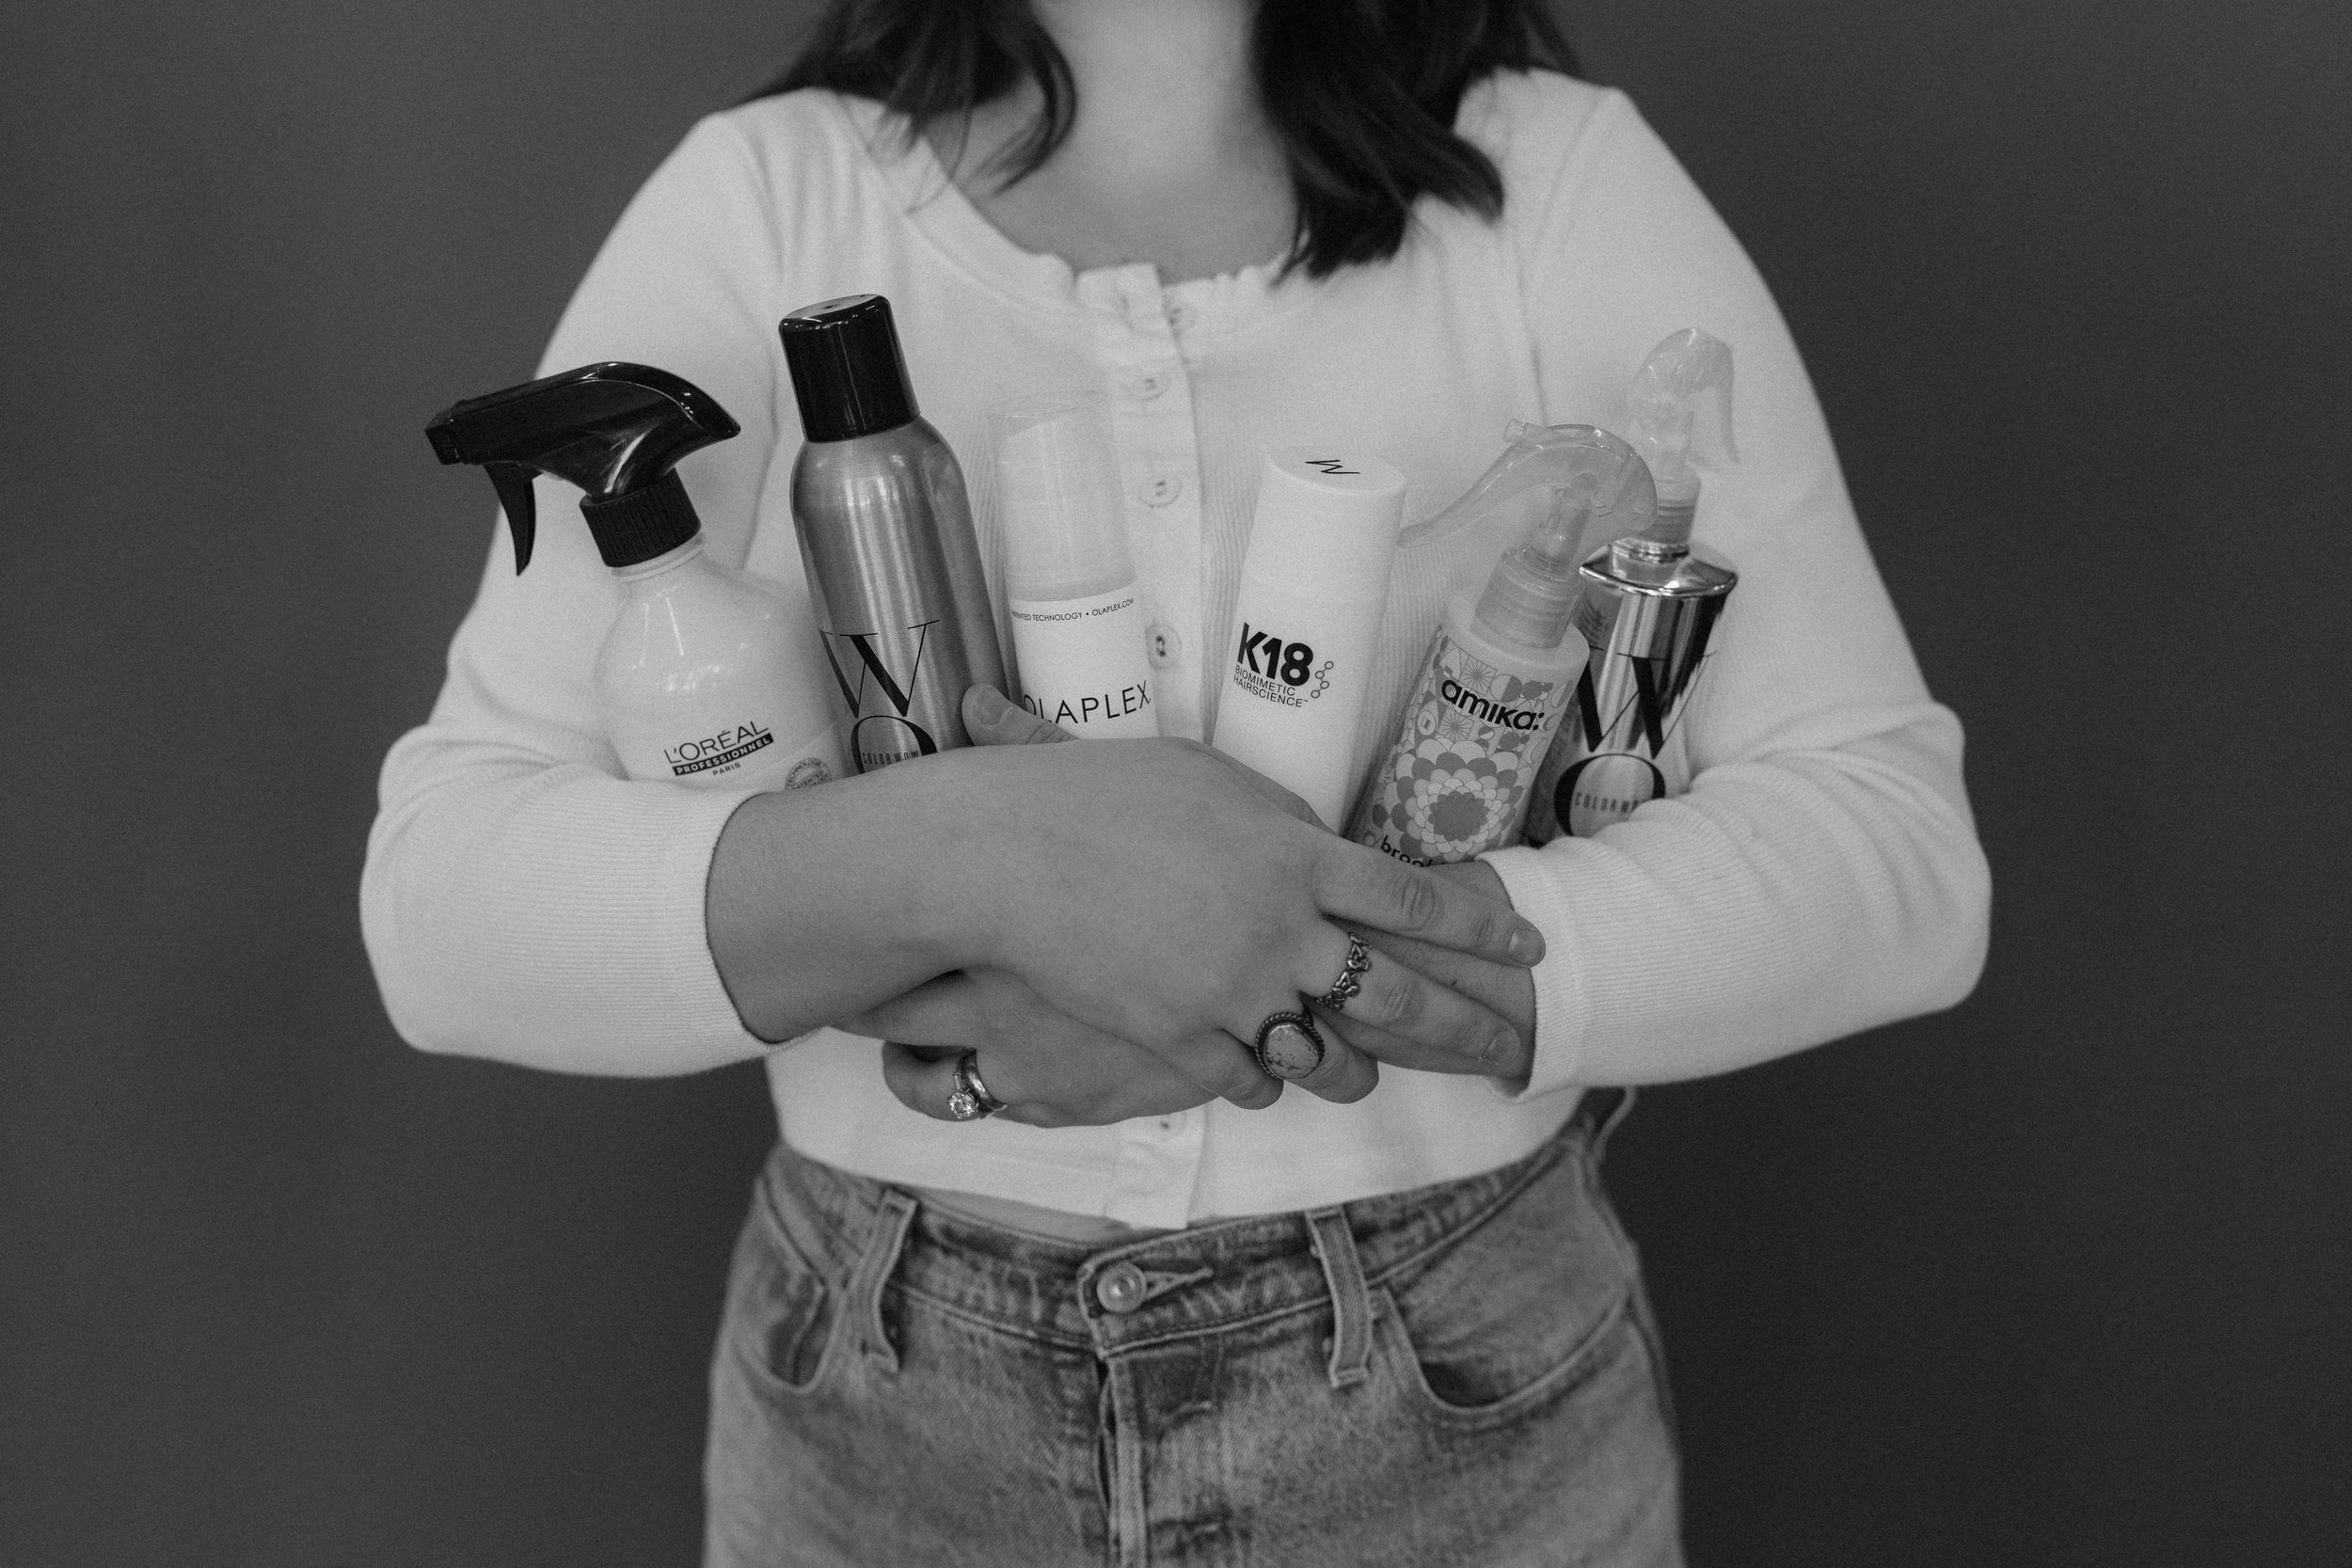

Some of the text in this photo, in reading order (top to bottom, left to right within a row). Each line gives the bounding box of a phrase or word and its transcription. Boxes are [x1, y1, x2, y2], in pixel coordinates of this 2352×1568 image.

[1032, 611, 1083, 622] TECHNOLOGY
[1091, 597, 1134, 616] OLAPLEX.COM
[819, 619, 940, 720] W
[1237, 622, 1313, 687] K18
[1234, 664, 1295, 697] BIOMIMETIC
[664, 721, 769, 764] L'ORÉAL
[674, 734, 773, 775] PROFESSIONNEL
[712, 762, 741, 776] PARIS
